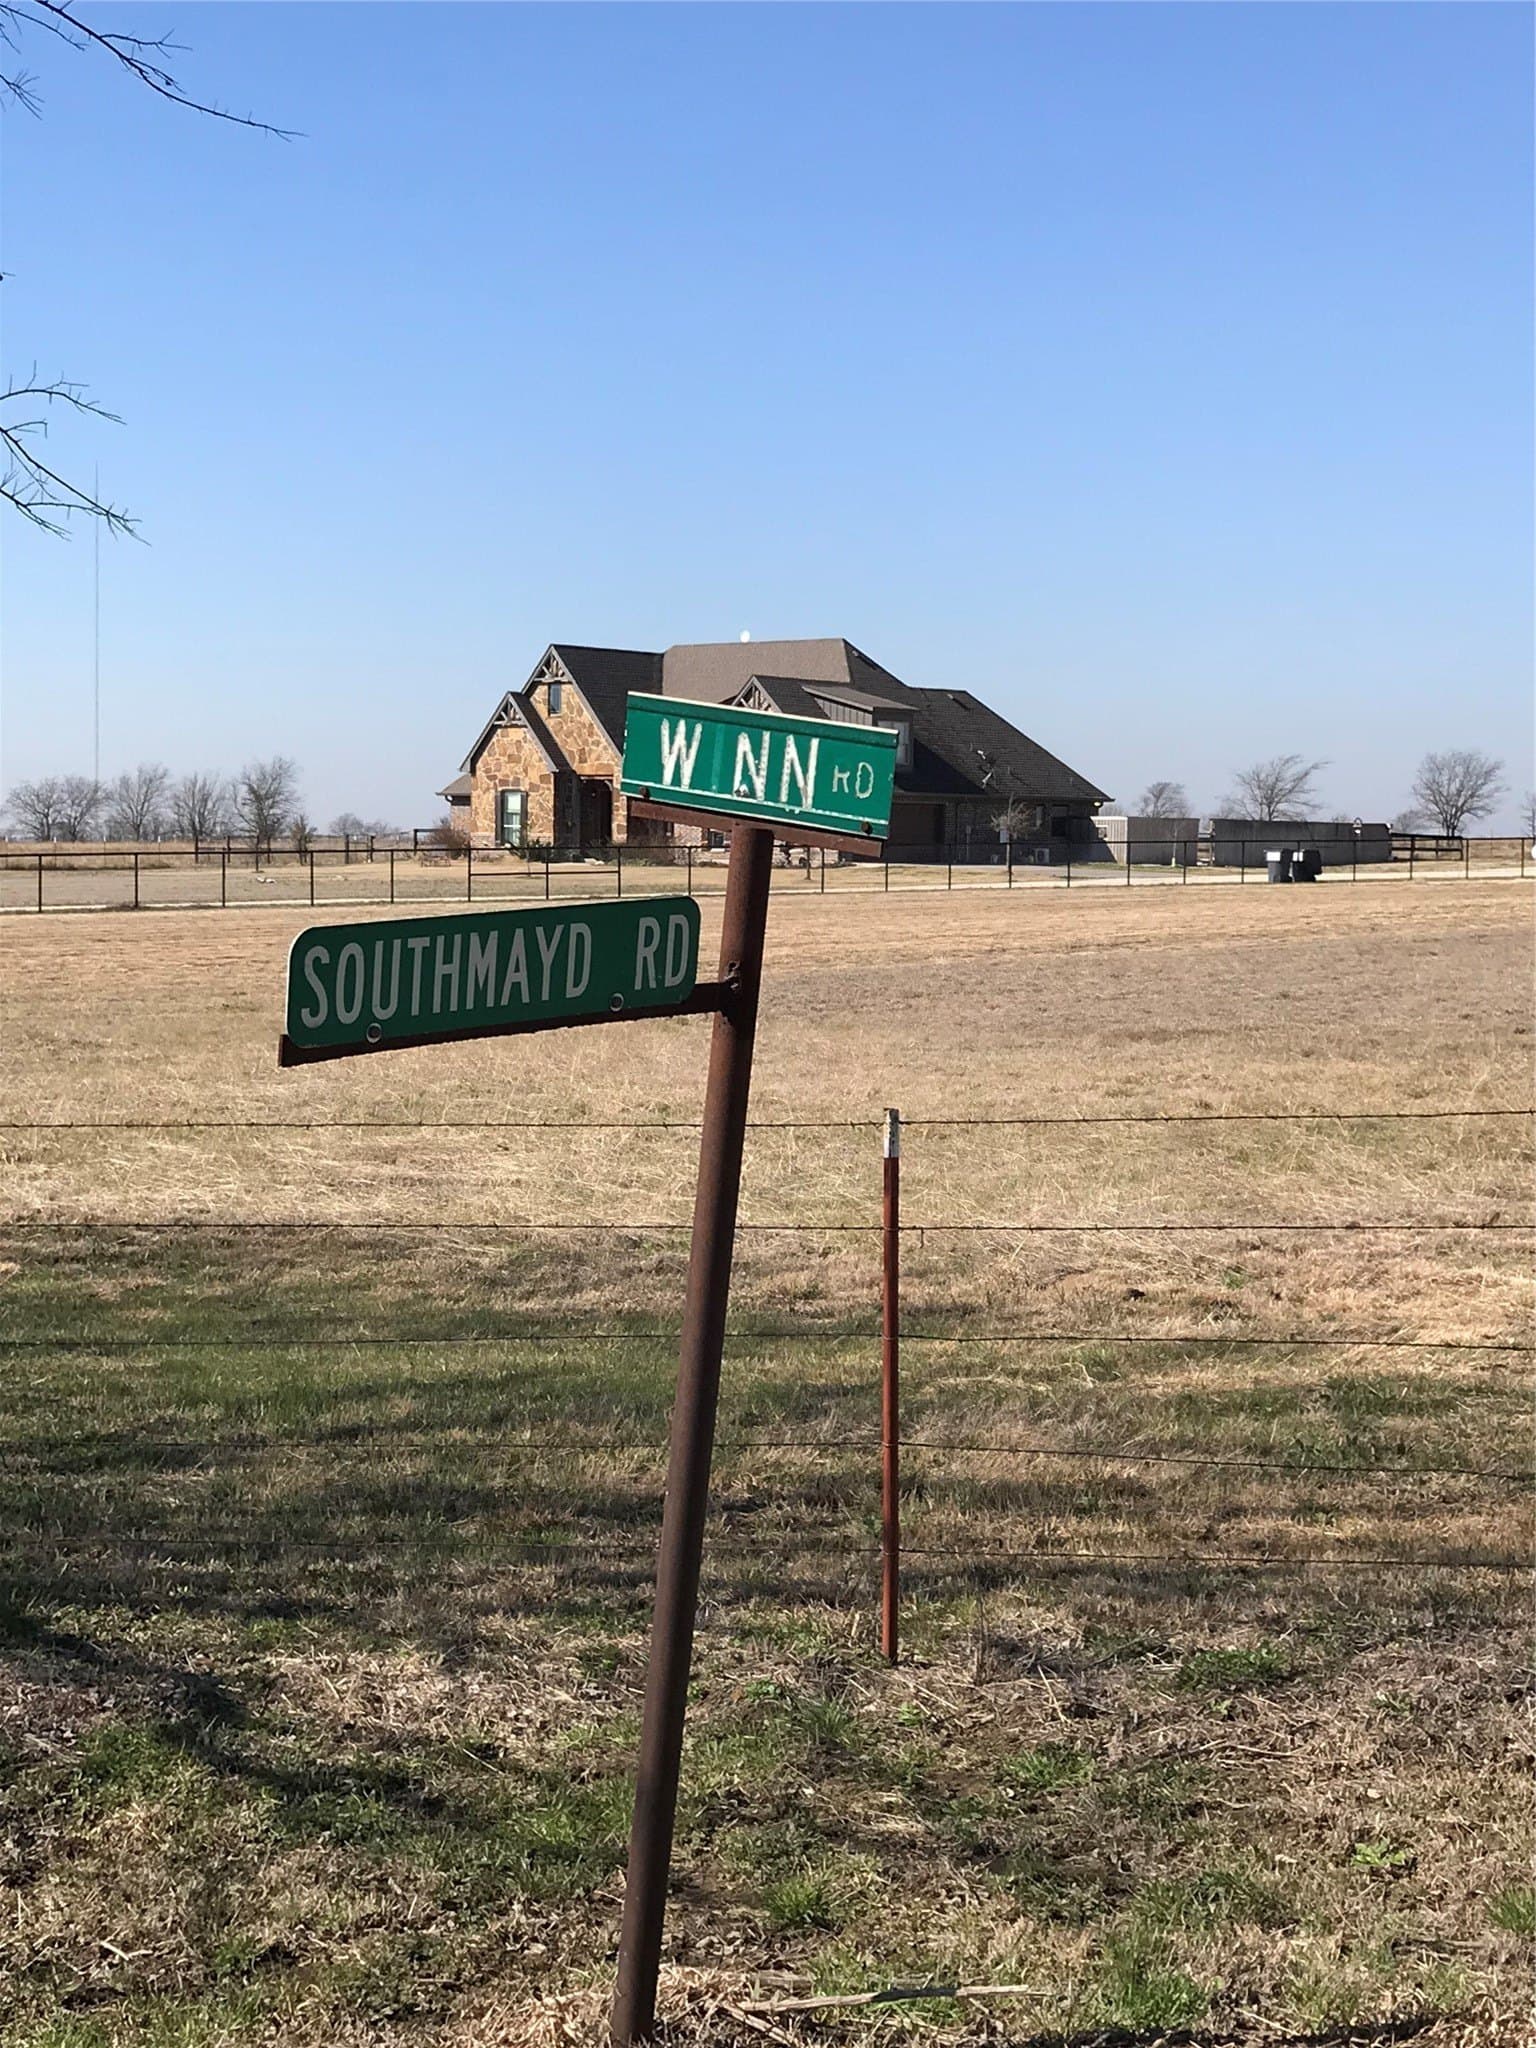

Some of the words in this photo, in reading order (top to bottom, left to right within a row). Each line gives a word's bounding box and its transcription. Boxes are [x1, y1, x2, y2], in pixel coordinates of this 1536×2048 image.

[832, 761, 874, 800] RD
[301, 922, 593, 1029] SOUTHMAYD
[634, 914, 690, 991] RD
